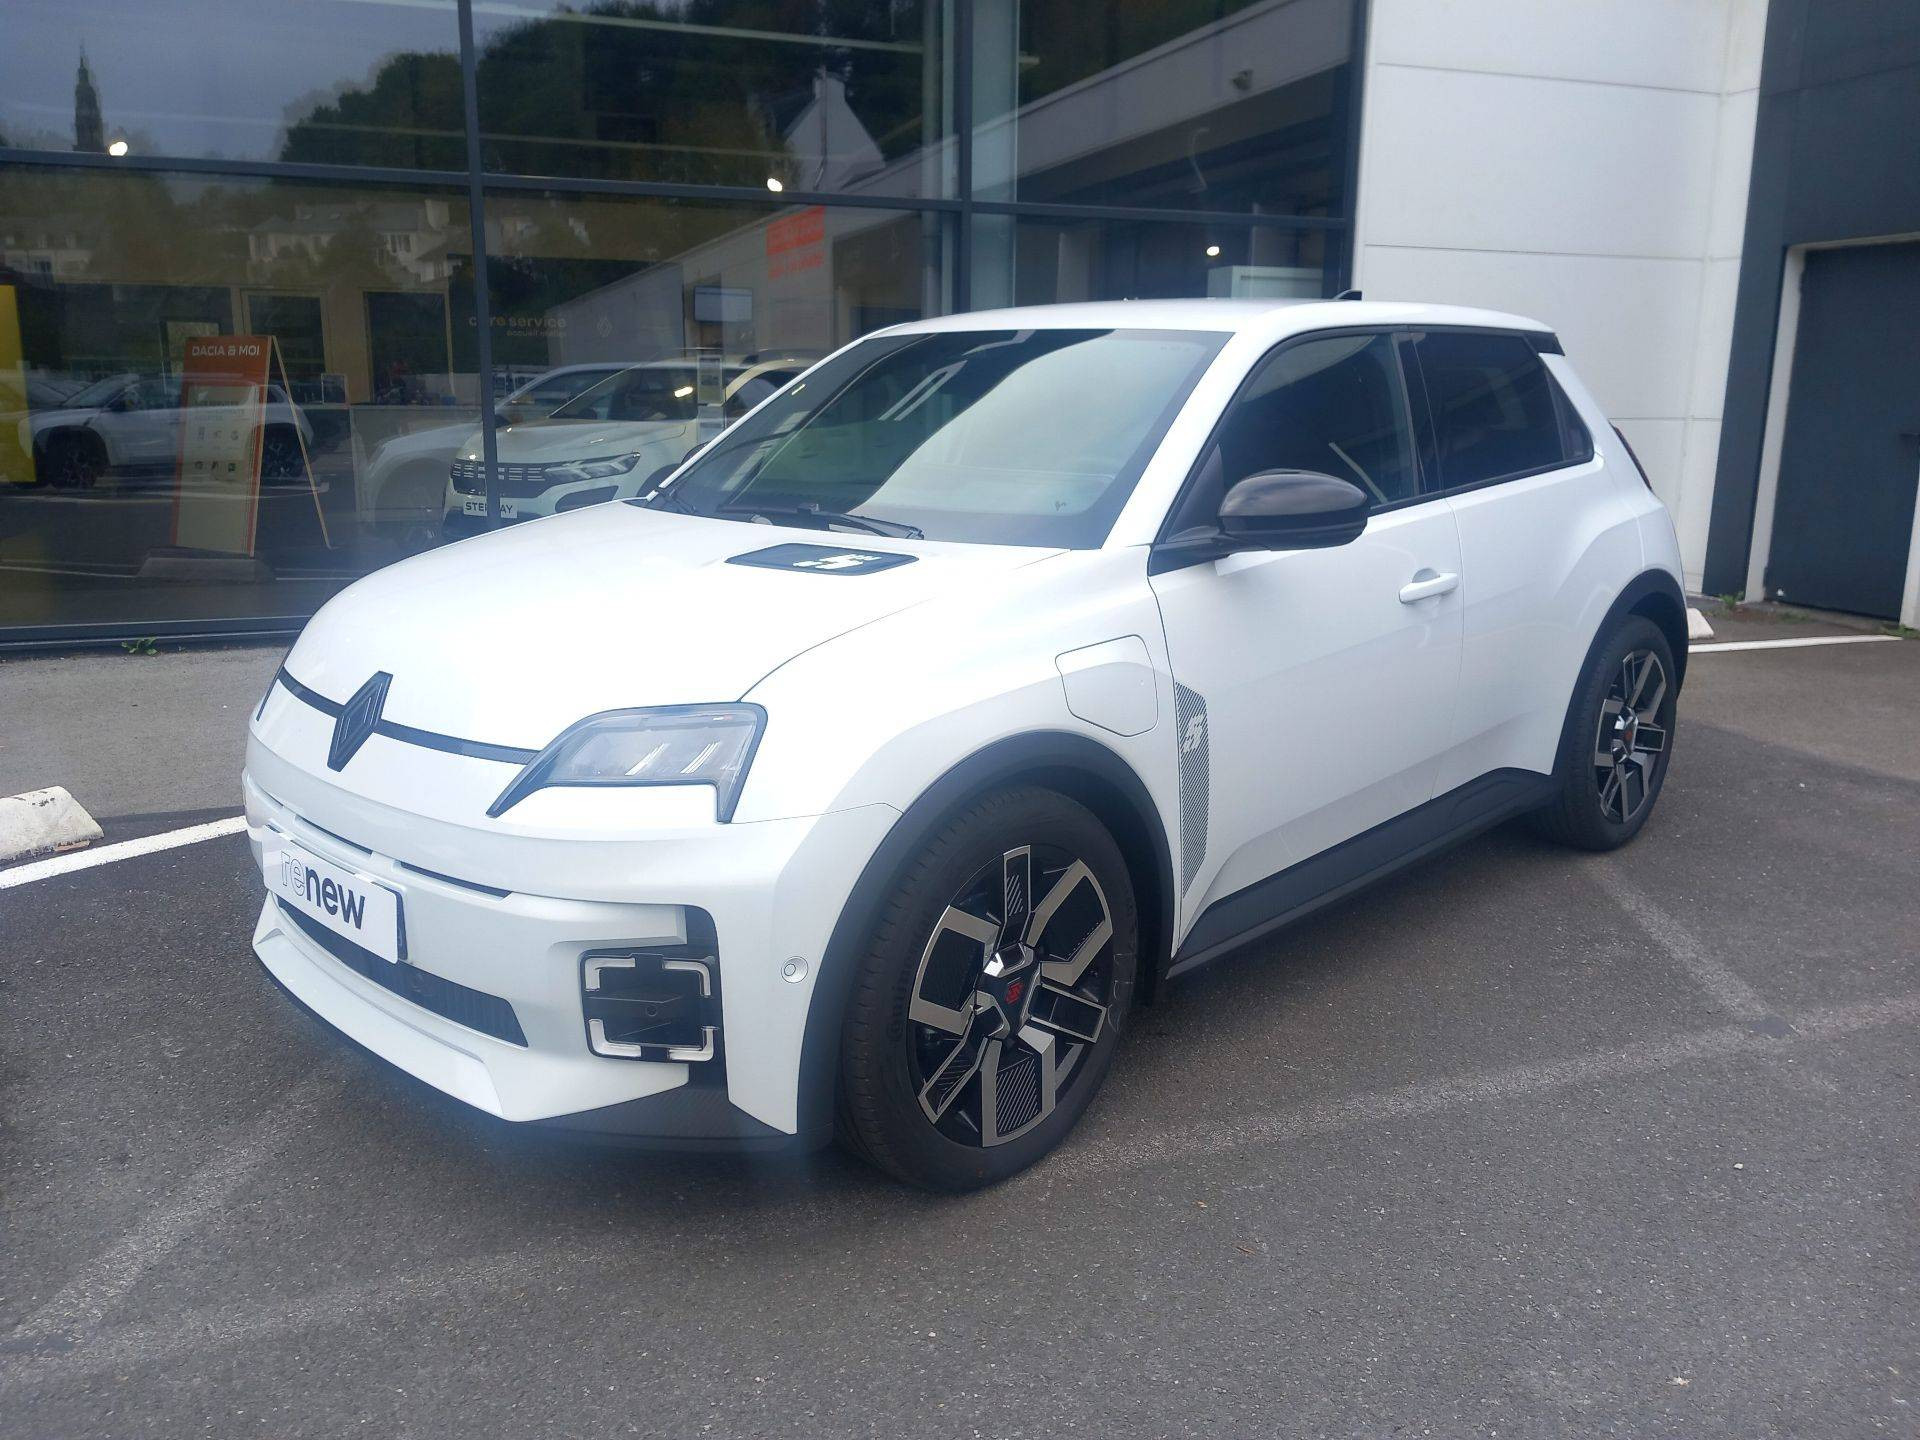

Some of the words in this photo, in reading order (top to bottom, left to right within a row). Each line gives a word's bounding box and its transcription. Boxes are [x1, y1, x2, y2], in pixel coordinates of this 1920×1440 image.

[468, 315, 505, 327] cre
[508, 316, 567, 328] service
[192, 345, 225, 357] DACIA
[239, 345, 260, 357] MOI
[465, 501, 513, 515] STEAY
[280, 850, 366, 931] renew
